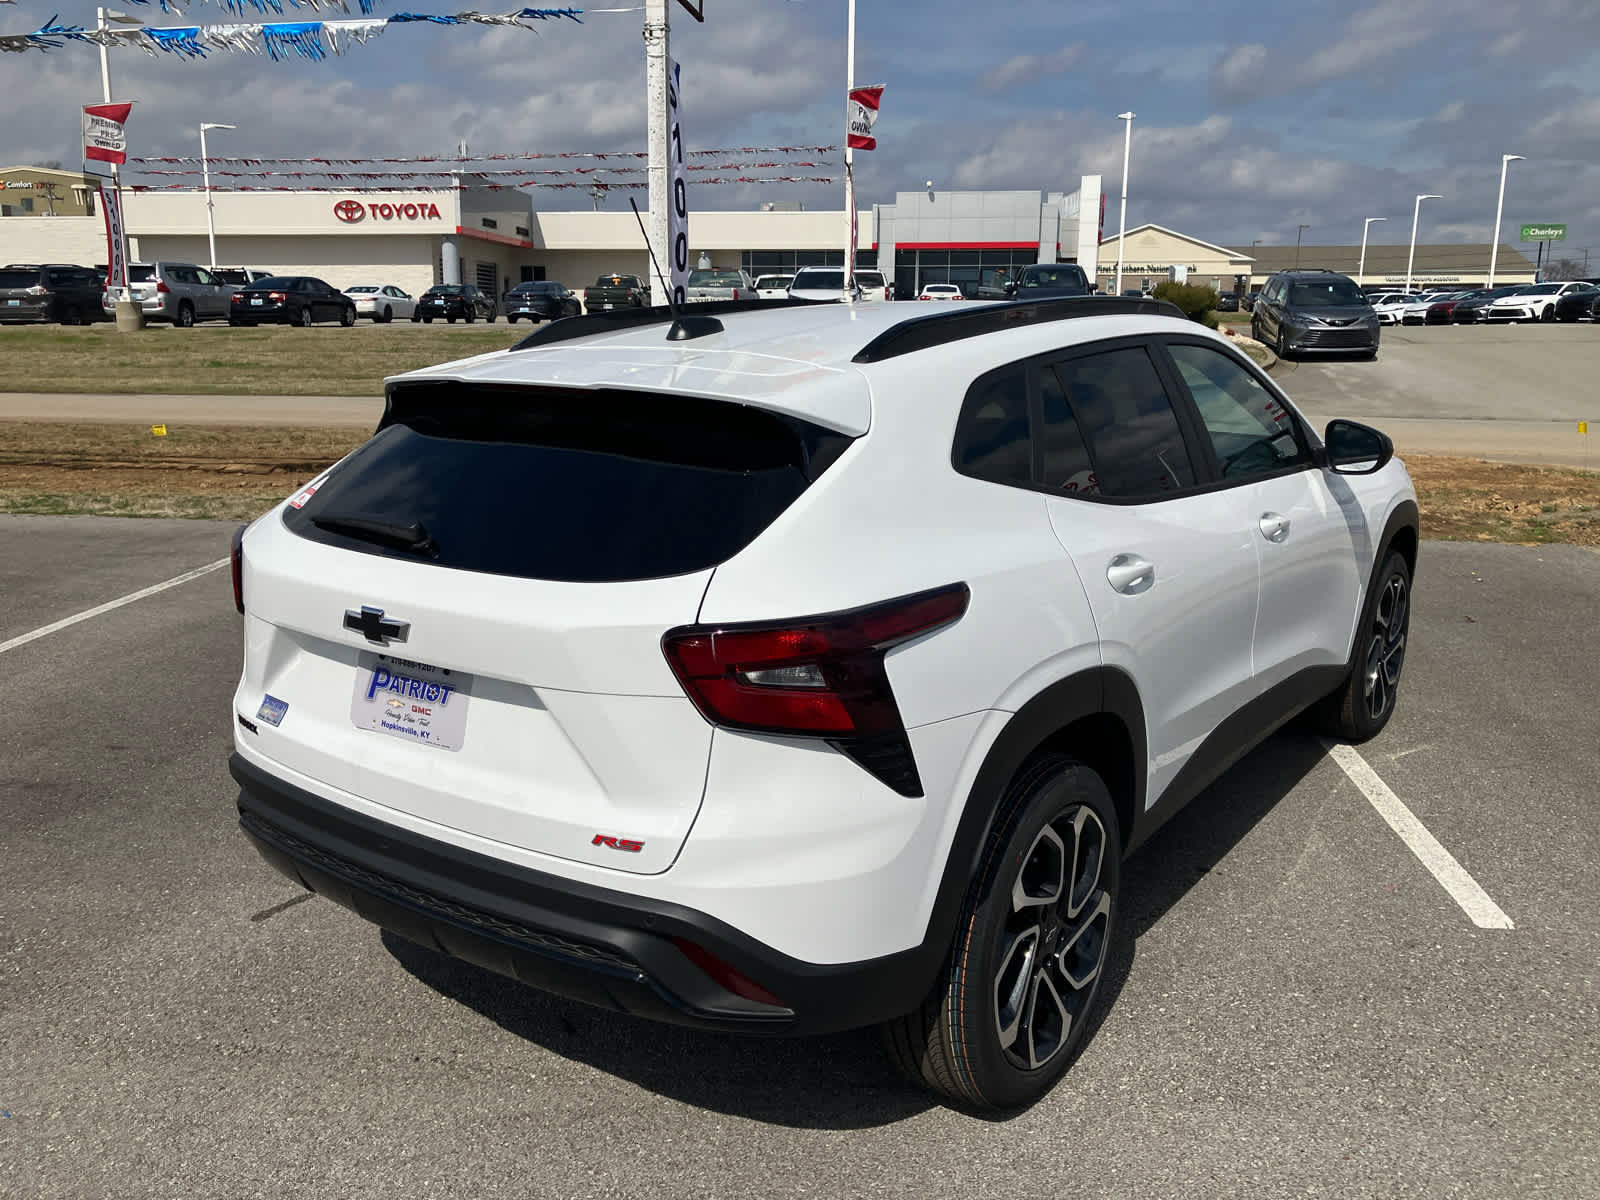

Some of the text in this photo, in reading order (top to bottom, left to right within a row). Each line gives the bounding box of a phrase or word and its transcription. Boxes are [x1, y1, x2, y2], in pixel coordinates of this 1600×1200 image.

[851, 121, 871, 135] OWNE
[94, 139, 121, 149] OWNED
[6, 181, 33, 189] Comfort
[368, 203, 441, 219] TOYOTA
[1530, 228, 1562, 238] Charleys
[1112, 264, 1145, 273] Suthern
[366, 664, 457, 706] PATRIOT
[411, 704, 432, 716] GMC
[380, 719, 431, 740] Hopkinsville, KY
[591, 834, 646, 853] RS
